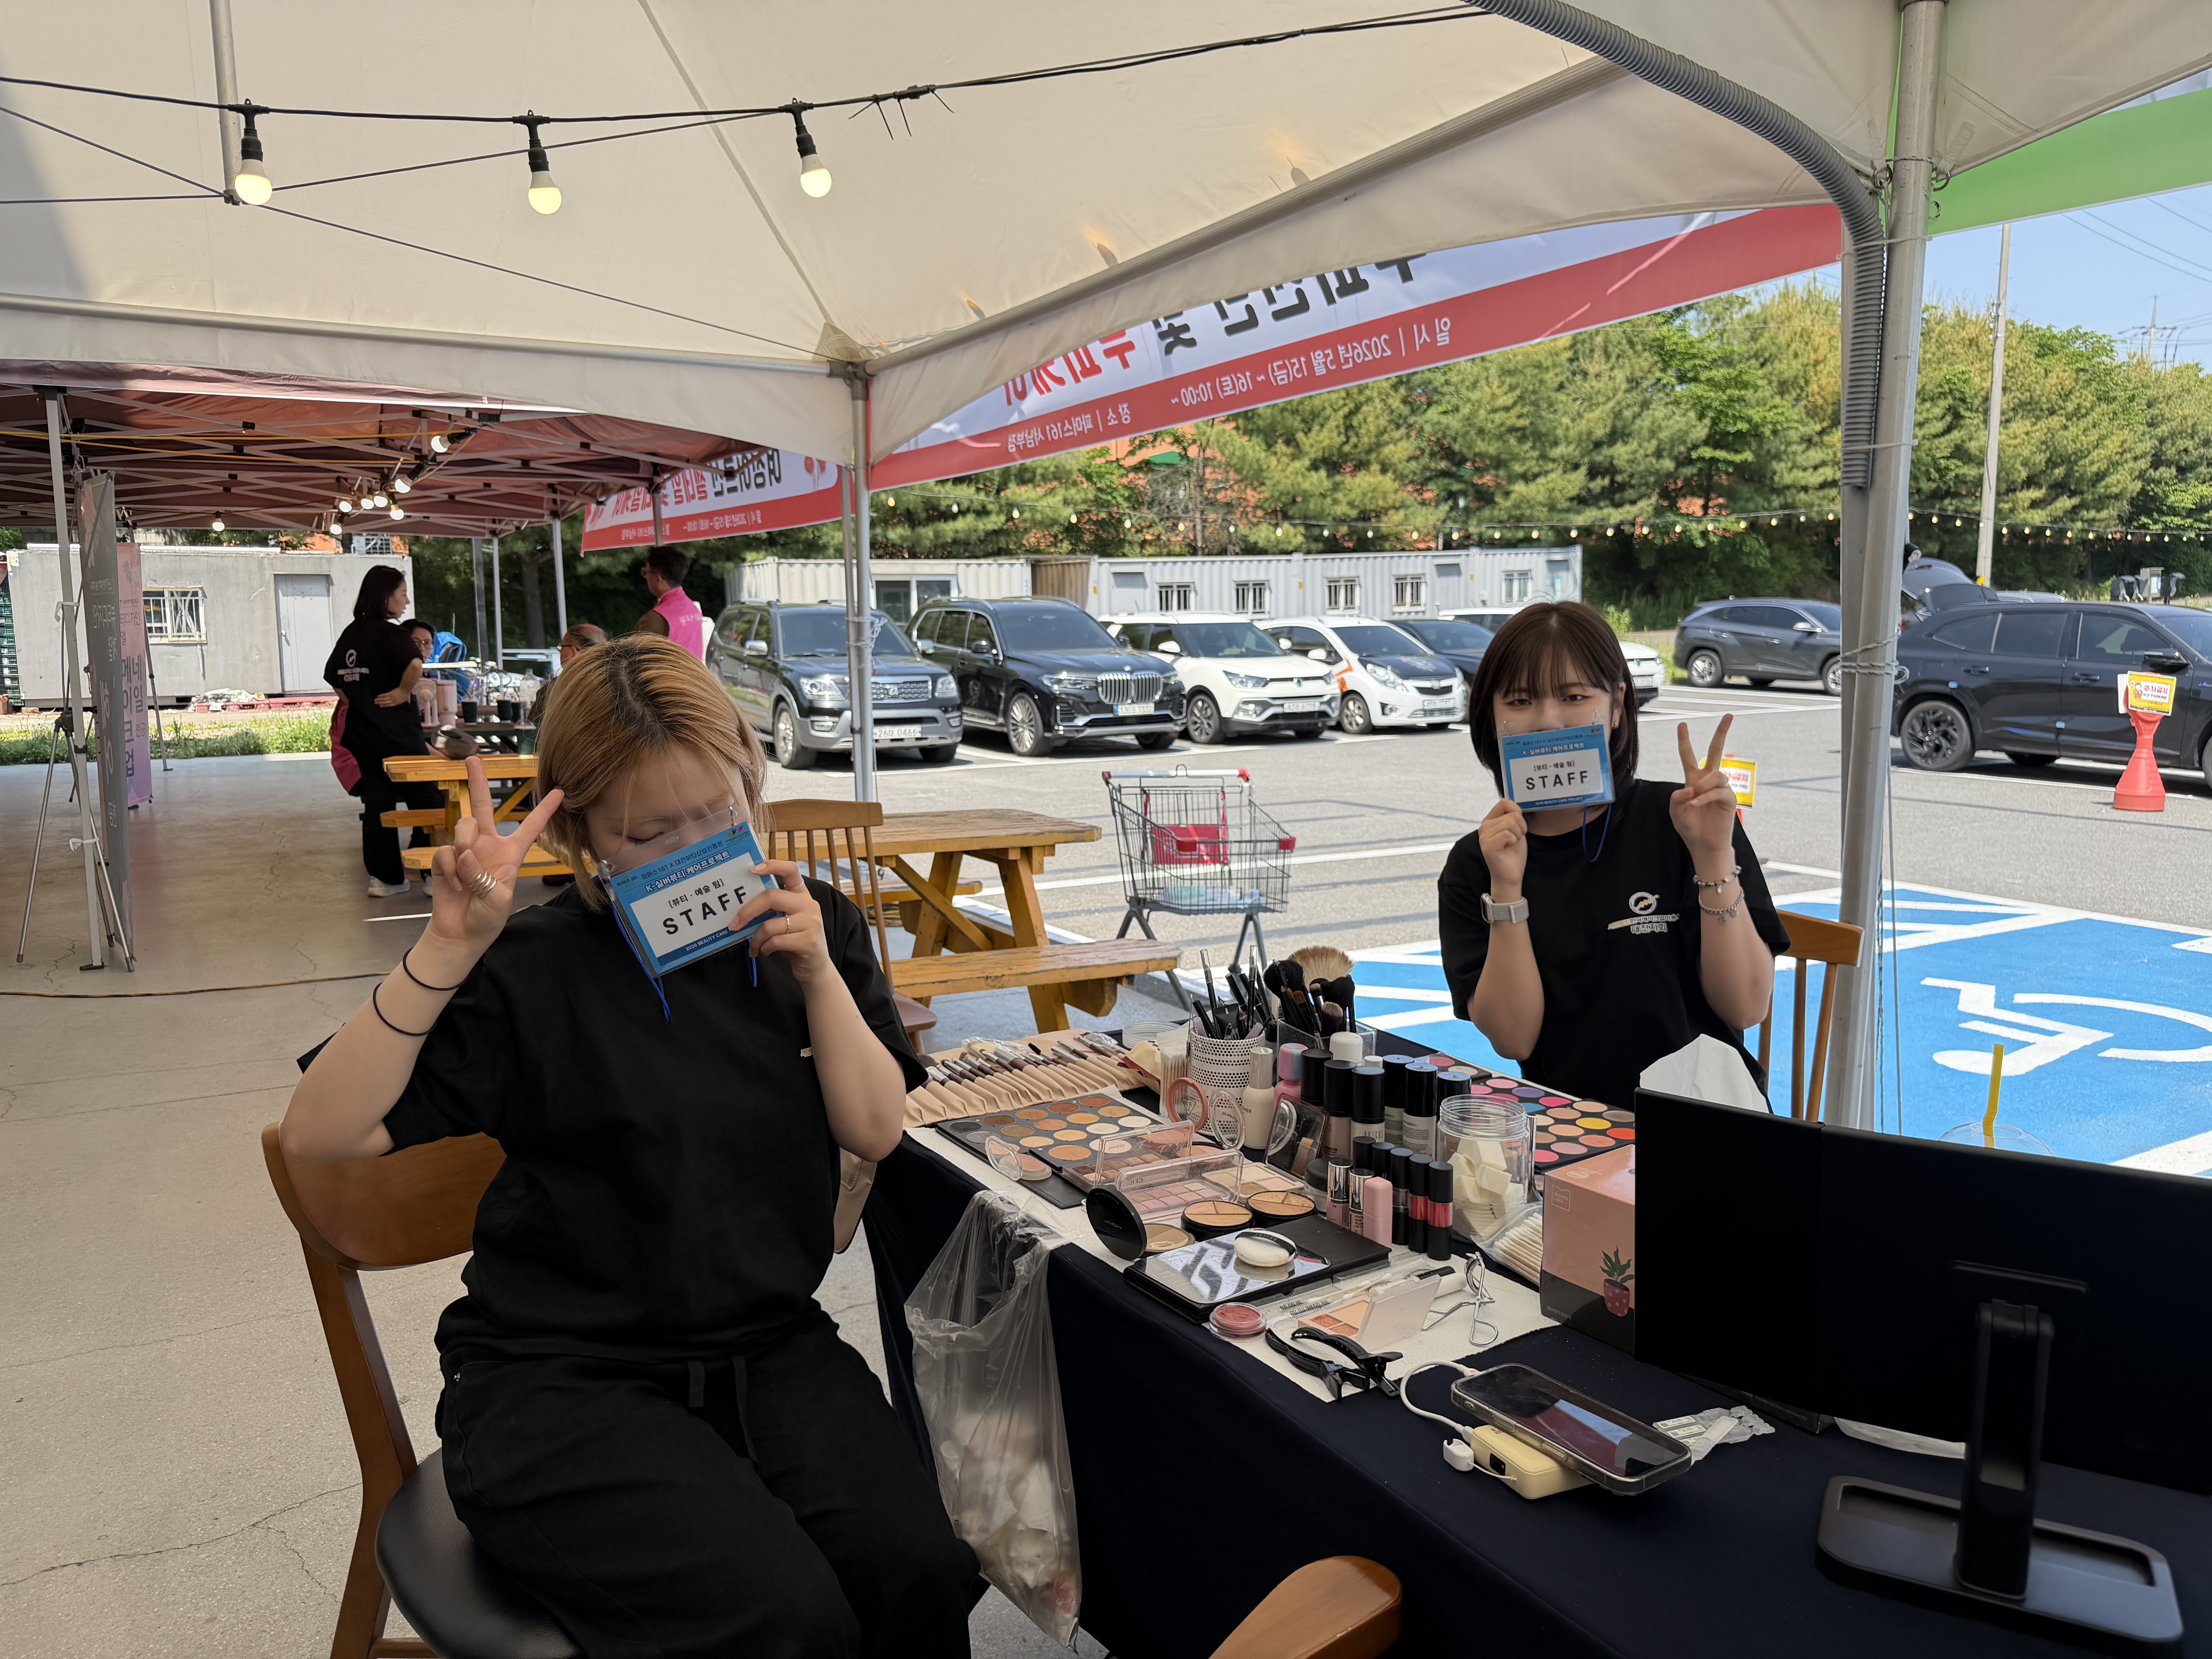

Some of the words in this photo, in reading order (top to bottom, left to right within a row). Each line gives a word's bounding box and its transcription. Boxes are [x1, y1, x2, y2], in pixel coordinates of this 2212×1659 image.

[120, 611, 140, 627] 티디자인
[120, 631, 126, 646] 열
[132, 654, 143, 713] 네일
[1526, 771, 1587, 790] STAFF
[641, 864, 669, 880] 파머스161
[675, 842, 723, 866] 대전뷰티산업진흥원
[645, 871, 685, 893] K-실버뷰티
[686, 850, 731, 875] 케어프로젝트
[668, 893, 689, 908] [뷰티
[694, 884, 712, 897] 예술
[711, 878, 725, 890] 팀]
[663, 885, 747, 935] STAFF
[698, 935, 715, 946] BEAUTY
[716, 929, 728, 938] CARE
